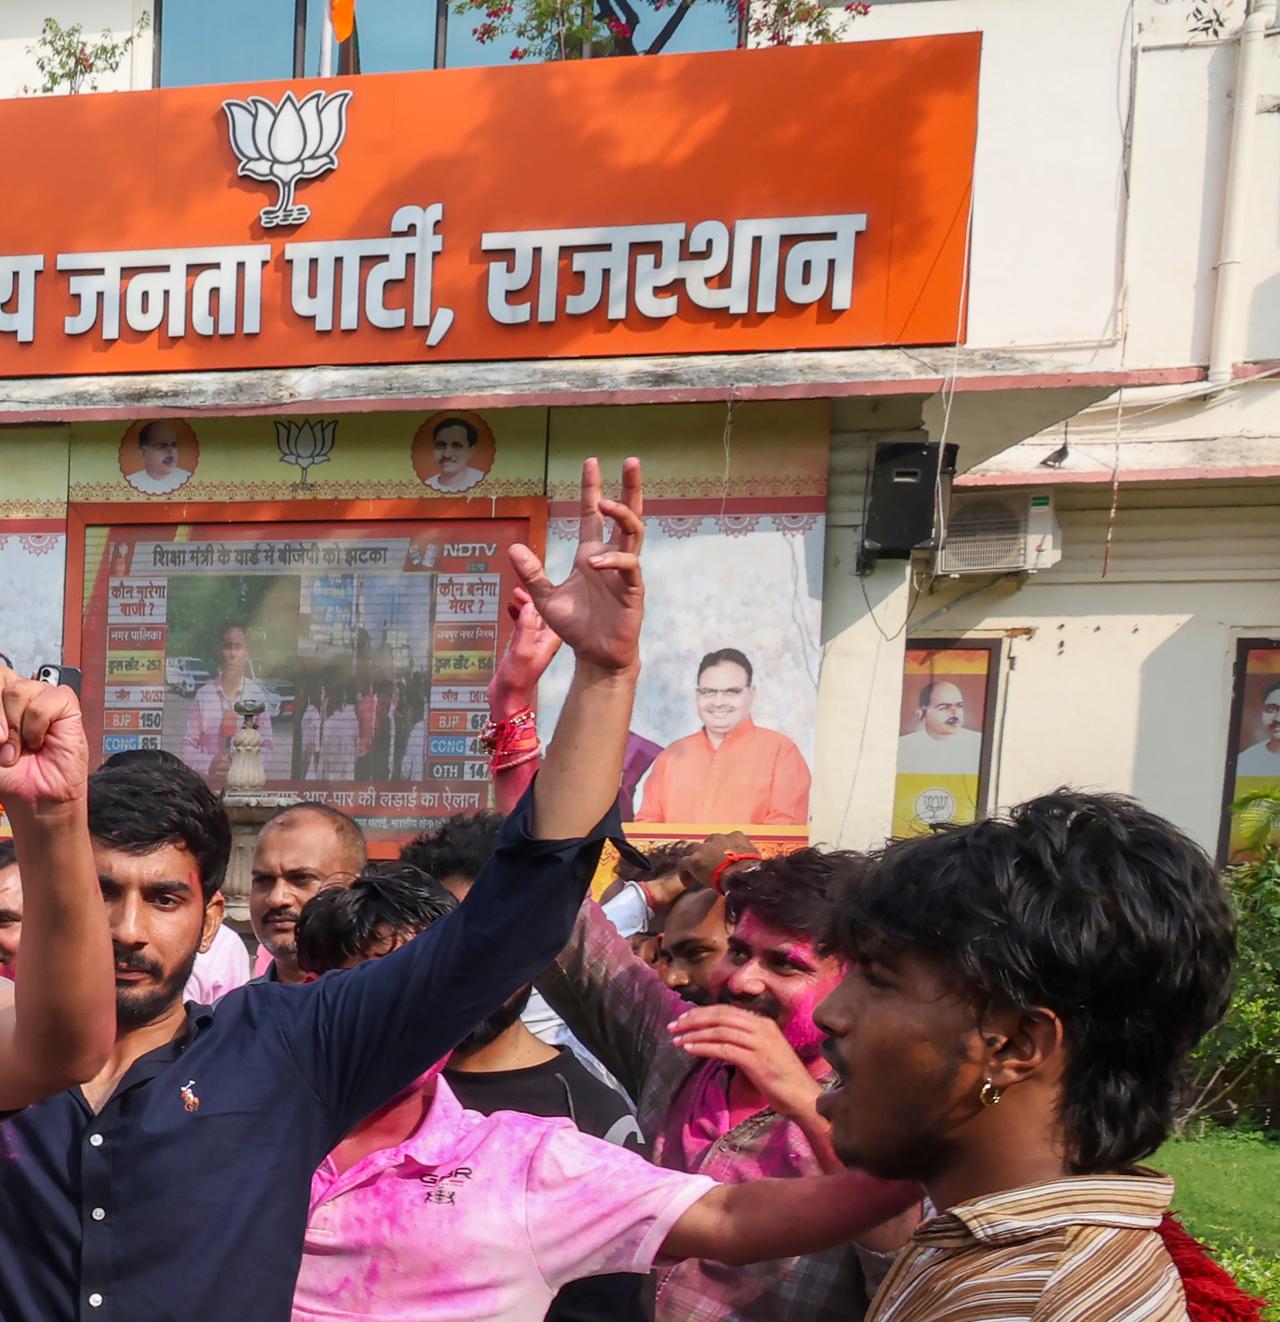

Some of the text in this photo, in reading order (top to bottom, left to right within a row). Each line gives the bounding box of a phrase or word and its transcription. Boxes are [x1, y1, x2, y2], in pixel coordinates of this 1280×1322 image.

[56, 244, 272, 340] जनता
[284, 203, 455, 346] पार्टी,
[481, 212, 868, 325] राजस्थान
[153, 544, 187, 567] शिक्षा
[189, 545, 215, 566] मंत्री
[217, 544, 234, 566] के
[234, 543, 261, 565] वार्ड
[263, 543, 277, 565] में
[278, 543, 320, 567] बीजेपी
[344, 546, 389, 567] झटका
[443, 543, 497, 557] NDTV
[111, 580, 134, 600] कौन
[438, 577, 465, 597] कौन
[112, 712, 160, 728] BJP 150
[439, 715, 460, 729] BJP
[105, 738, 137, 751] CONG
[430, 740, 464, 753] CONG
[433, 764, 458, 778] OTH
[358, 785, 376, 808] की
[380, 786, 417, 811] लड़ाई
[421, 791, 439, 808] का
[443, 787, 480, 810] ऐलान
